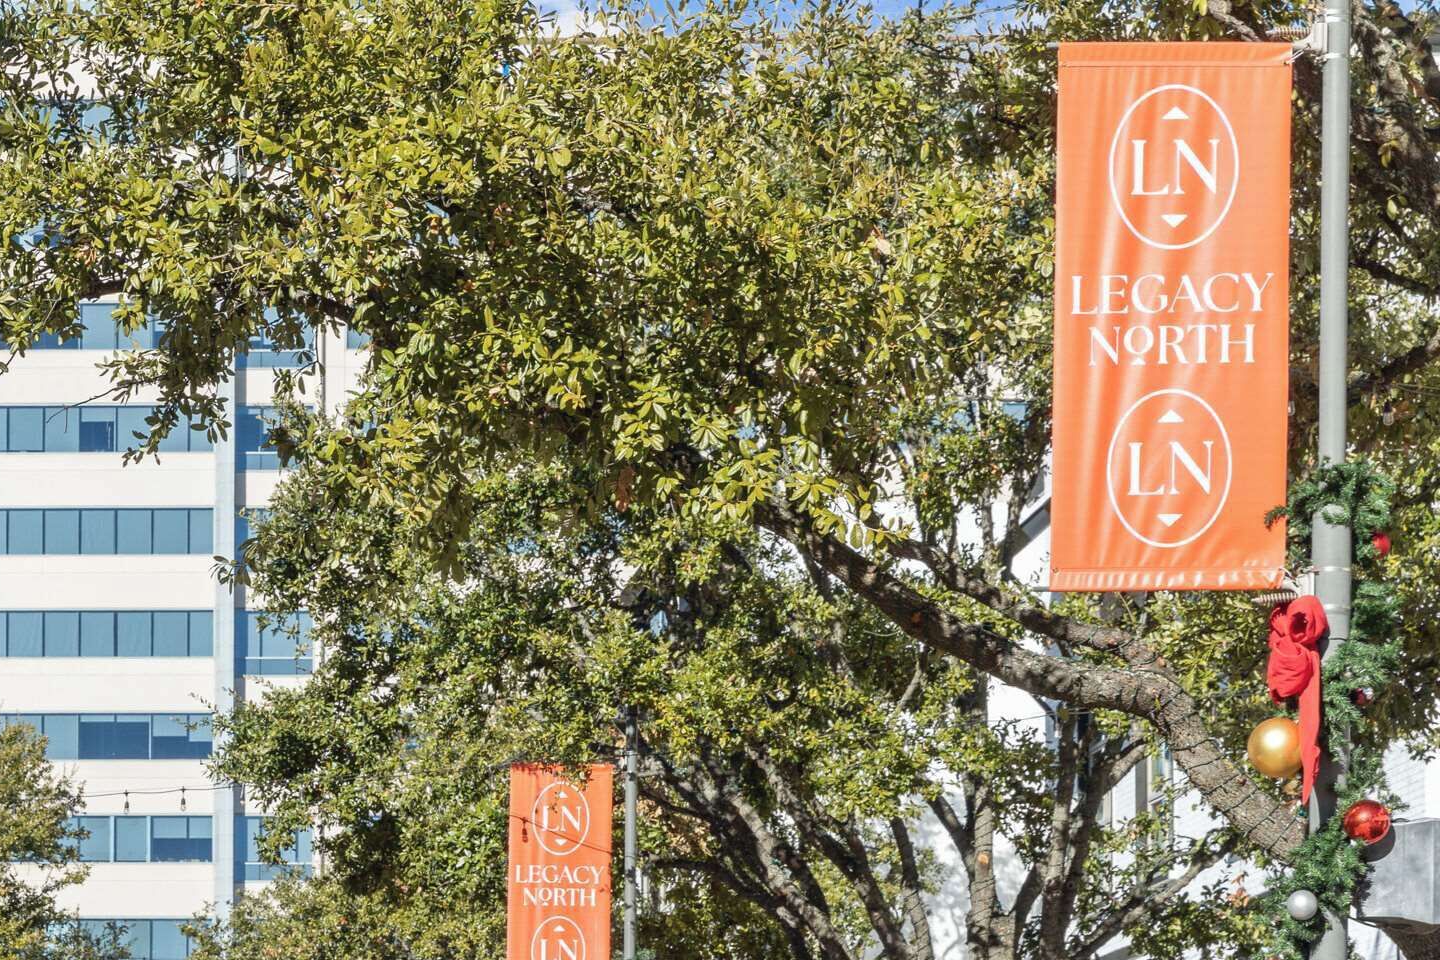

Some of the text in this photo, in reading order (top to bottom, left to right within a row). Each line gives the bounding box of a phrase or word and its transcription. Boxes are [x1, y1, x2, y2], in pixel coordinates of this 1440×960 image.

[1132, 138, 1220, 197] LN
[1071, 271, 1274, 316] LEGACY
[1088, 322, 1255, 366] NORTH
[1128, 440, 1213, 496] LN
[541, 805, 581, 831] LN
[515, 864, 604, 885] LEGACY
[523, 887, 596, 907] NORTH
